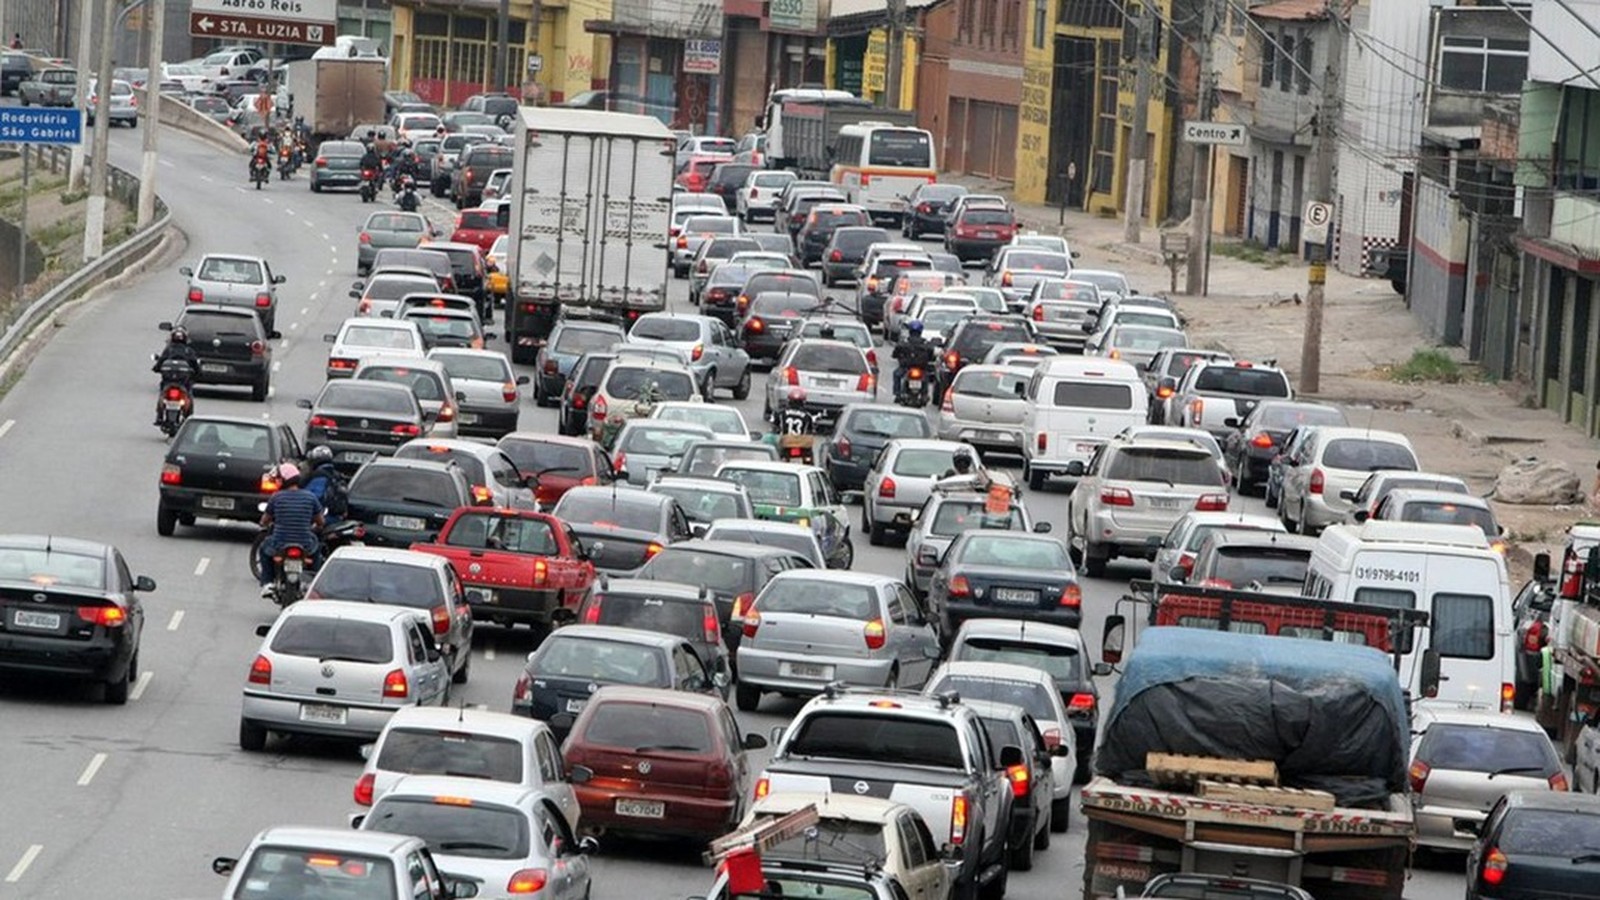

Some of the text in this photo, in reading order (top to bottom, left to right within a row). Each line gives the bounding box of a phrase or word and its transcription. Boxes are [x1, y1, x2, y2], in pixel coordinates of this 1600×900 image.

[270, 0, 302, 12] Reis
[220, 20, 301, 38] STA. LUZIA
[1, 112, 68, 124] Rodoviária
[2, 126, 76, 138] São Gabriel
[1188, 126, 1226, 139] Centro
[1313, 207, 1322, 221] E
[785, 417, 803, 435] 13
[1104, 798, 1187, 817] OBRIGADO
[1304, 818, 1382, 834] SENHOR
